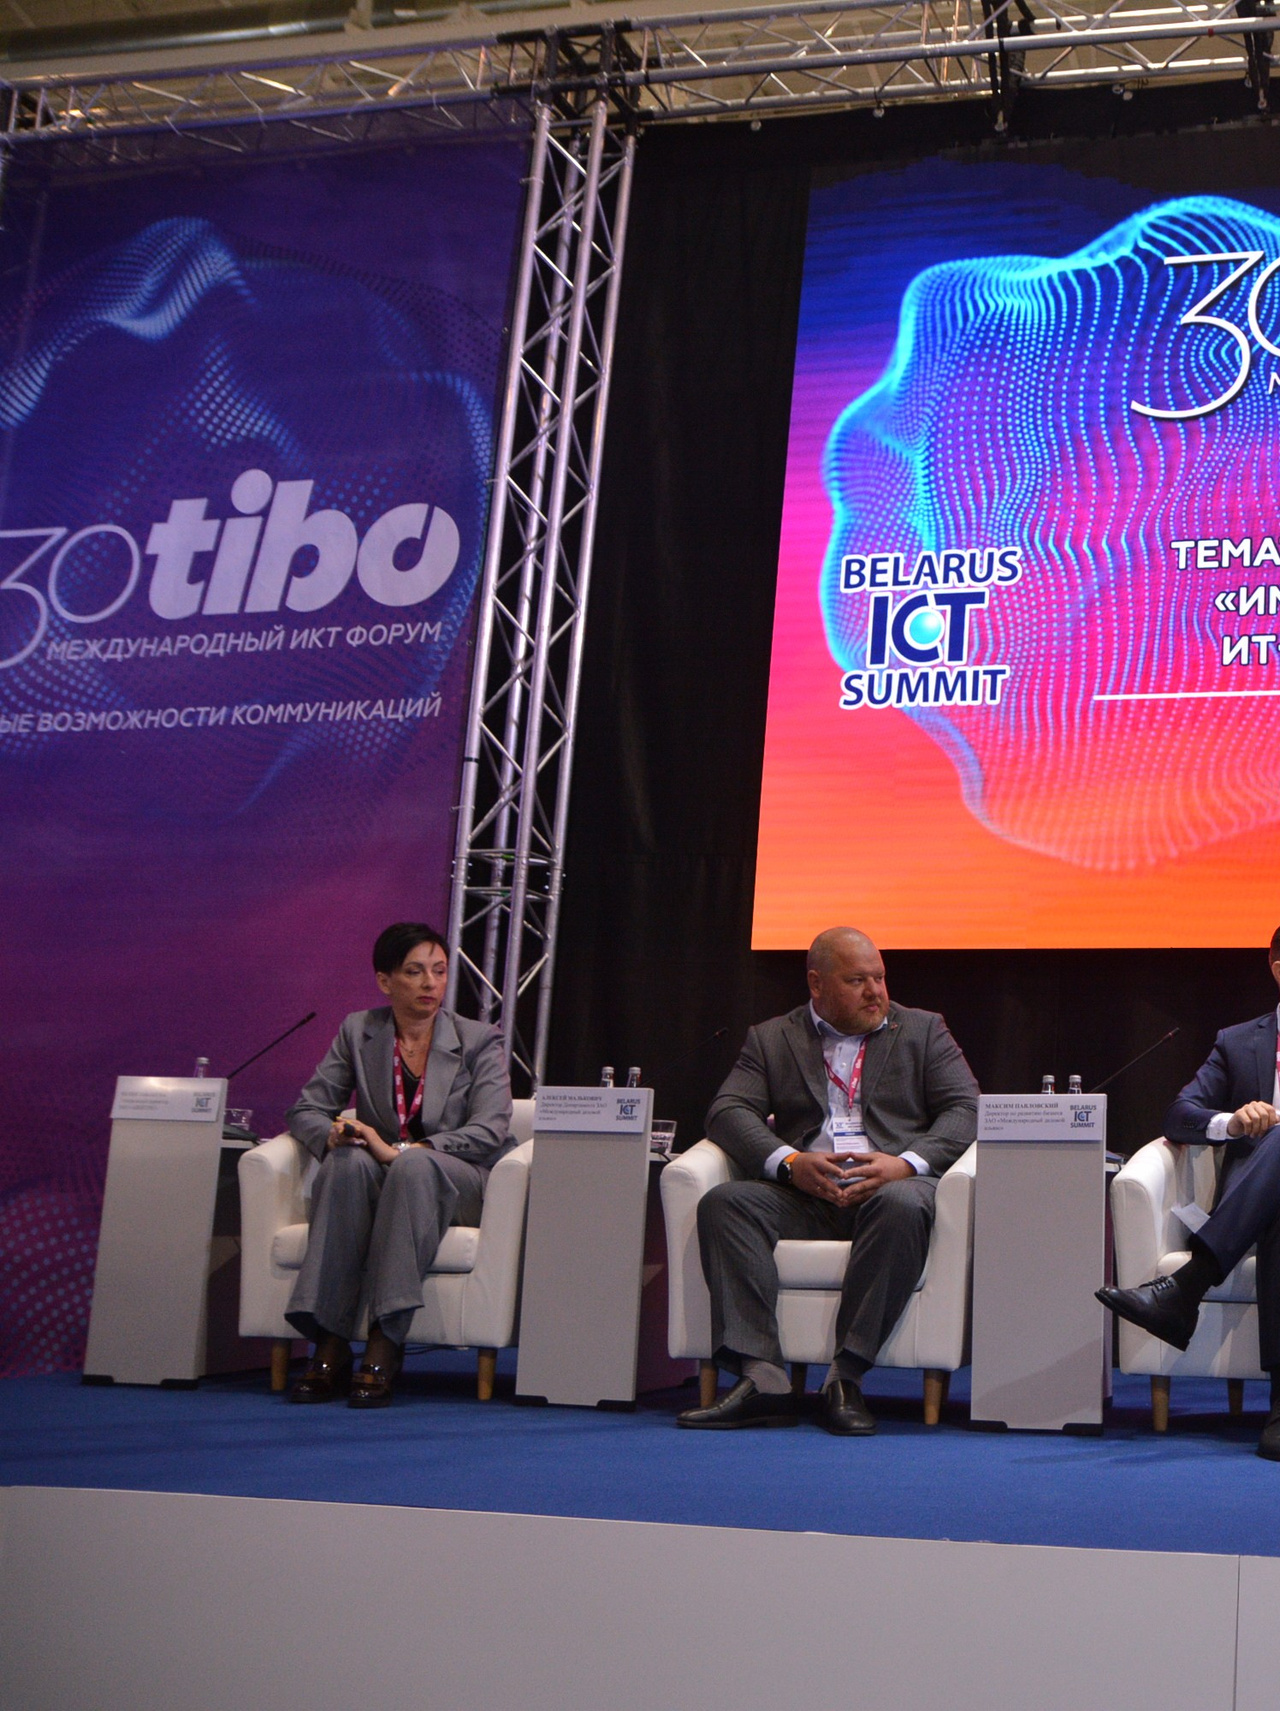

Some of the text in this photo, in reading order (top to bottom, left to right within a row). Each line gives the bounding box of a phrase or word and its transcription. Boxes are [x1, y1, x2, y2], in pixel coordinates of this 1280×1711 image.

[145, 469, 460, 620] tibo
[842, 549, 1021, 590] BELARUS
[46, 621, 443, 663] МЕЖДУНАРОДНЫЙ ИКТ ФОРУМ
[868, 590, 988, 666] ICT
[841, 668, 1008, 706] SUMMIT
[36, 705, 227, 733] ВОЗМОЖНОСТИ
[231, 691, 443, 727] КОММУНИКАЦИЙ
[619, 1105, 636, 1115] ICT
[1074, 1111, 1092, 1122] ICT
